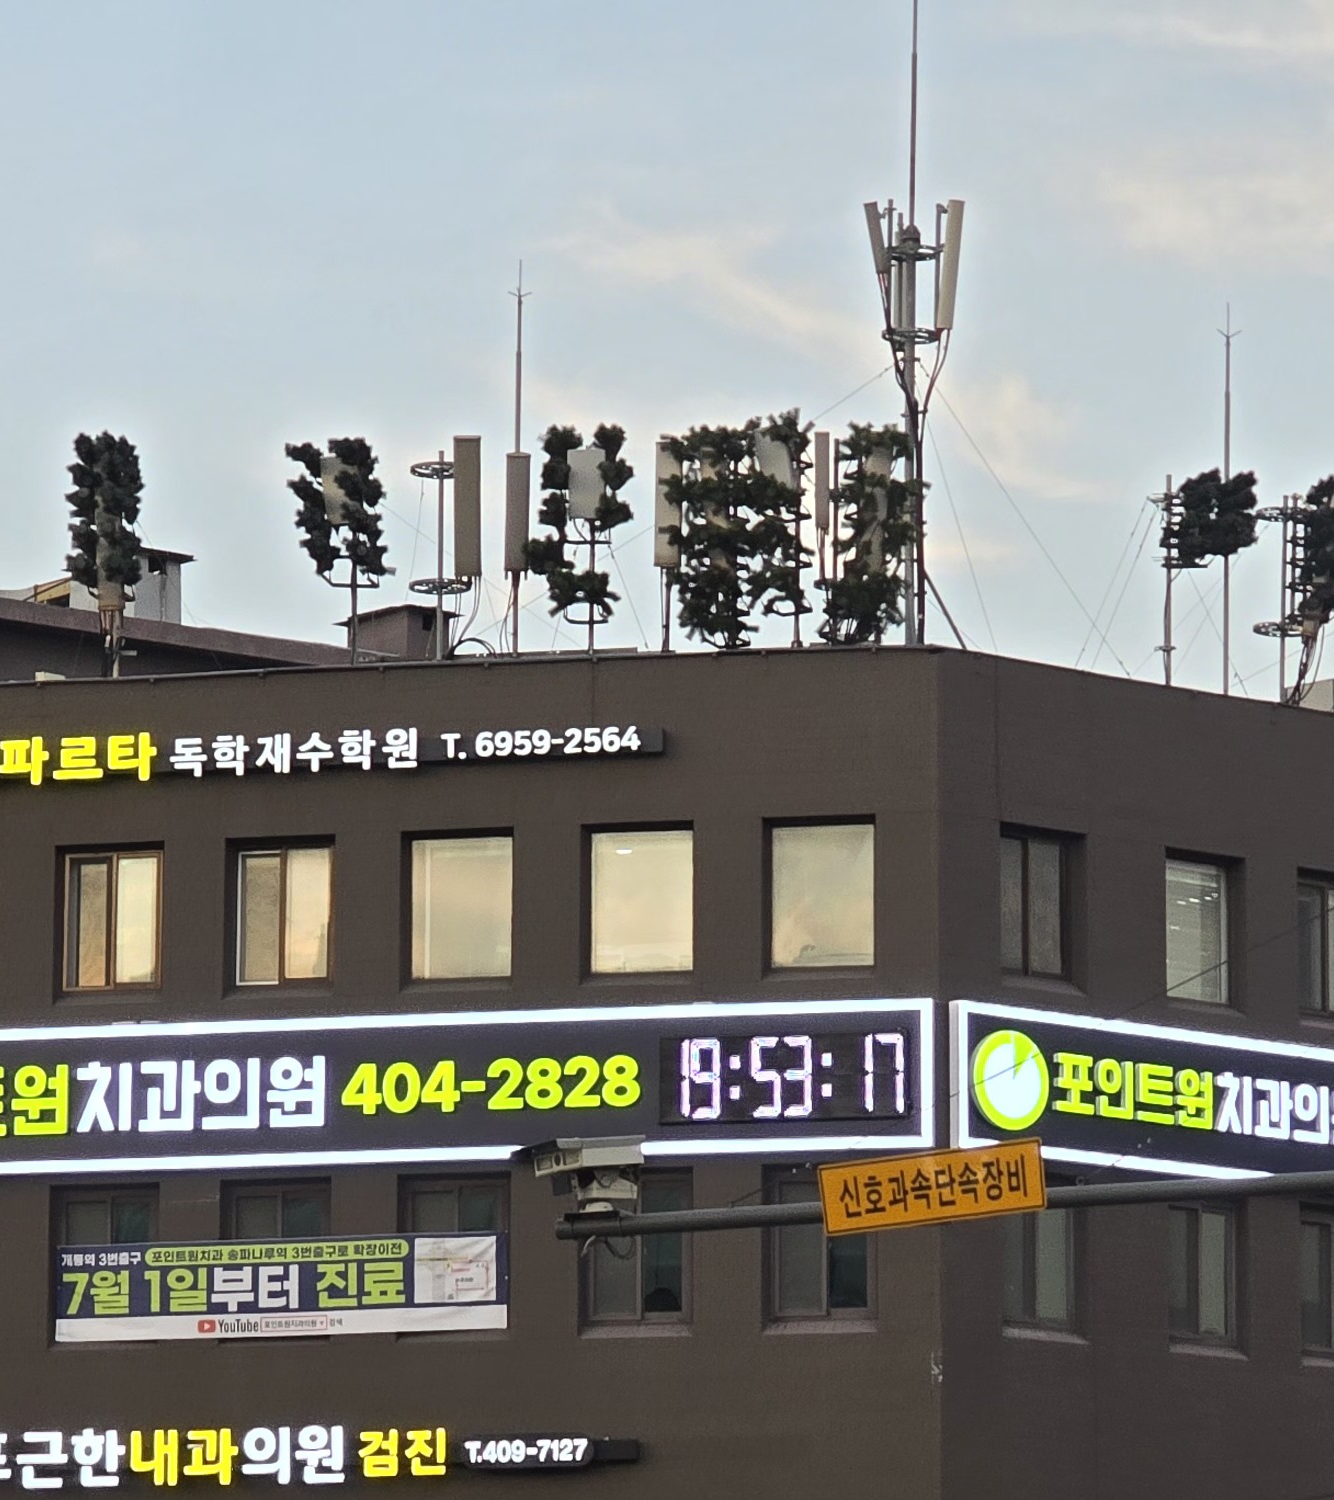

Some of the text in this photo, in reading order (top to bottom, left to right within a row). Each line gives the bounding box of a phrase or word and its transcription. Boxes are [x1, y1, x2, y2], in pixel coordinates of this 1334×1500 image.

[168, 726, 420, 778] 독학재수학원
[474, 724, 643, 759] 6959-2564
[341, 1055, 642, 1115] 404-2828
[839, 1153, 1029, 1219] 신호과속단속장비
[152, 1249, 223, 1263] 포인트원치과
[228, 1247, 287, 1260] 송파나루역
[291, 1244, 349, 1259] 3번출구로
[353, 1241, 402, 1257] 확장이전
[62, 1262, 406, 1315] 7월 1일부터 진료
[217, 1318, 259, 1333] YouTube
[358, 1427, 448, 1478] 검진
